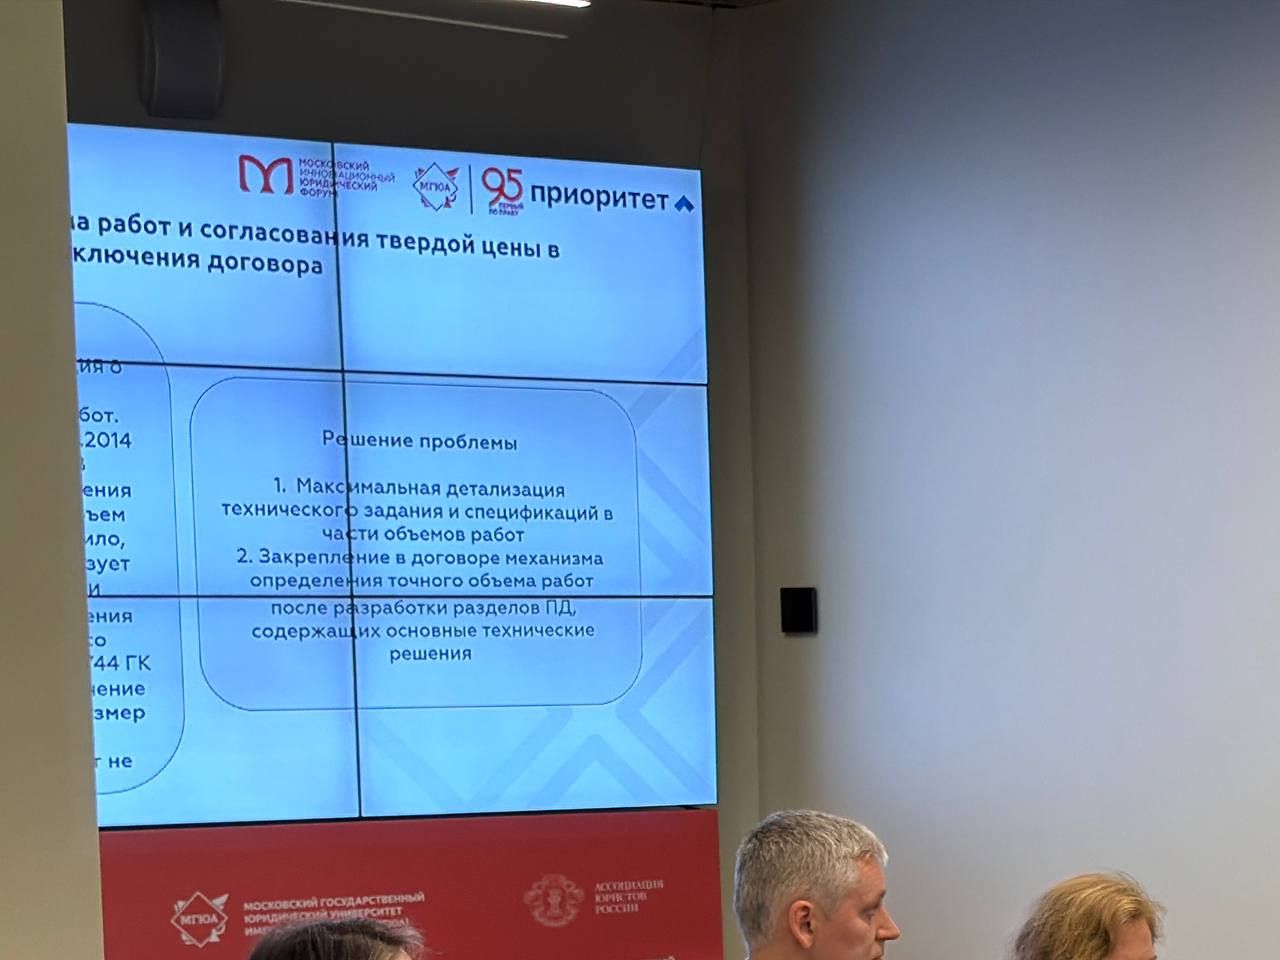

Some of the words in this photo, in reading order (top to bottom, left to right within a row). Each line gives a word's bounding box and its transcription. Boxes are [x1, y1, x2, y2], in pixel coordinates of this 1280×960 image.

[481, 167, 523, 207] 95
[531, 184, 669, 211] приоритет
[98, 213, 171, 236] работ
[179, 221, 193, 237] и
[200, 222, 369, 247] согласования
[376, 233, 475, 256] твердой
[482, 240, 541, 259] цены
[548, 244, 561, 258] в
[207, 253, 323, 278] договора
[322, 430, 413, 448] Решение
[420, 434, 518, 452] проблемы
[274, 477, 286, 493] 1.
[297, 478, 441, 495] Максимальная
[446, 483, 566, 499] детализация
[221, 502, 358, 518] технического
[364, 505, 443, 520] задания
[449, 507, 459, 519] и
[465, 505, 598, 523] спецификаций
[604, 509, 614, 521] в
[322, 528, 378, 541] части
[384, 526, 466, 541] объемов
[471, 527, 525, 544] работ
[237, 548, 253, 564] 2.
[259, 548, 390, 567] Закрепление
[396, 553, 406, 564] в
[411, 553, 500, 568] договоре
[505, 553, 604, 565] механизма
[250, 575, 383, 590] определения
[388, 576, 464, 588] точного
[468, 573, 537, 588] объема
[542, 573, 594, 590] работ
[272, 603, 328, 615] после
[334, 600, 447, 618] разработки
[454, 602, 540, 618] разделов
[546, 599, 577, 616] ПД,
[252, 626, 381, 641] содержащих
[386, 625, 477, 638] основные
[482, 625, 595, 637] технические
[91, 655, 120, 671] 44
[126, 655, 151, 671] ГК
[390, 648, 472, 664] решения
[92, 684, 146, 696] ение
[108, 756, 133, 768] не
[595, 880, 664, 892] АССОЦИАЦИЯ
[243, 896, 318, 911] МОСКОВСКИЙ
[595, 892, 647, 903] ЮРИСТОВ
[595, 904, 639, 914] РОССИИ
